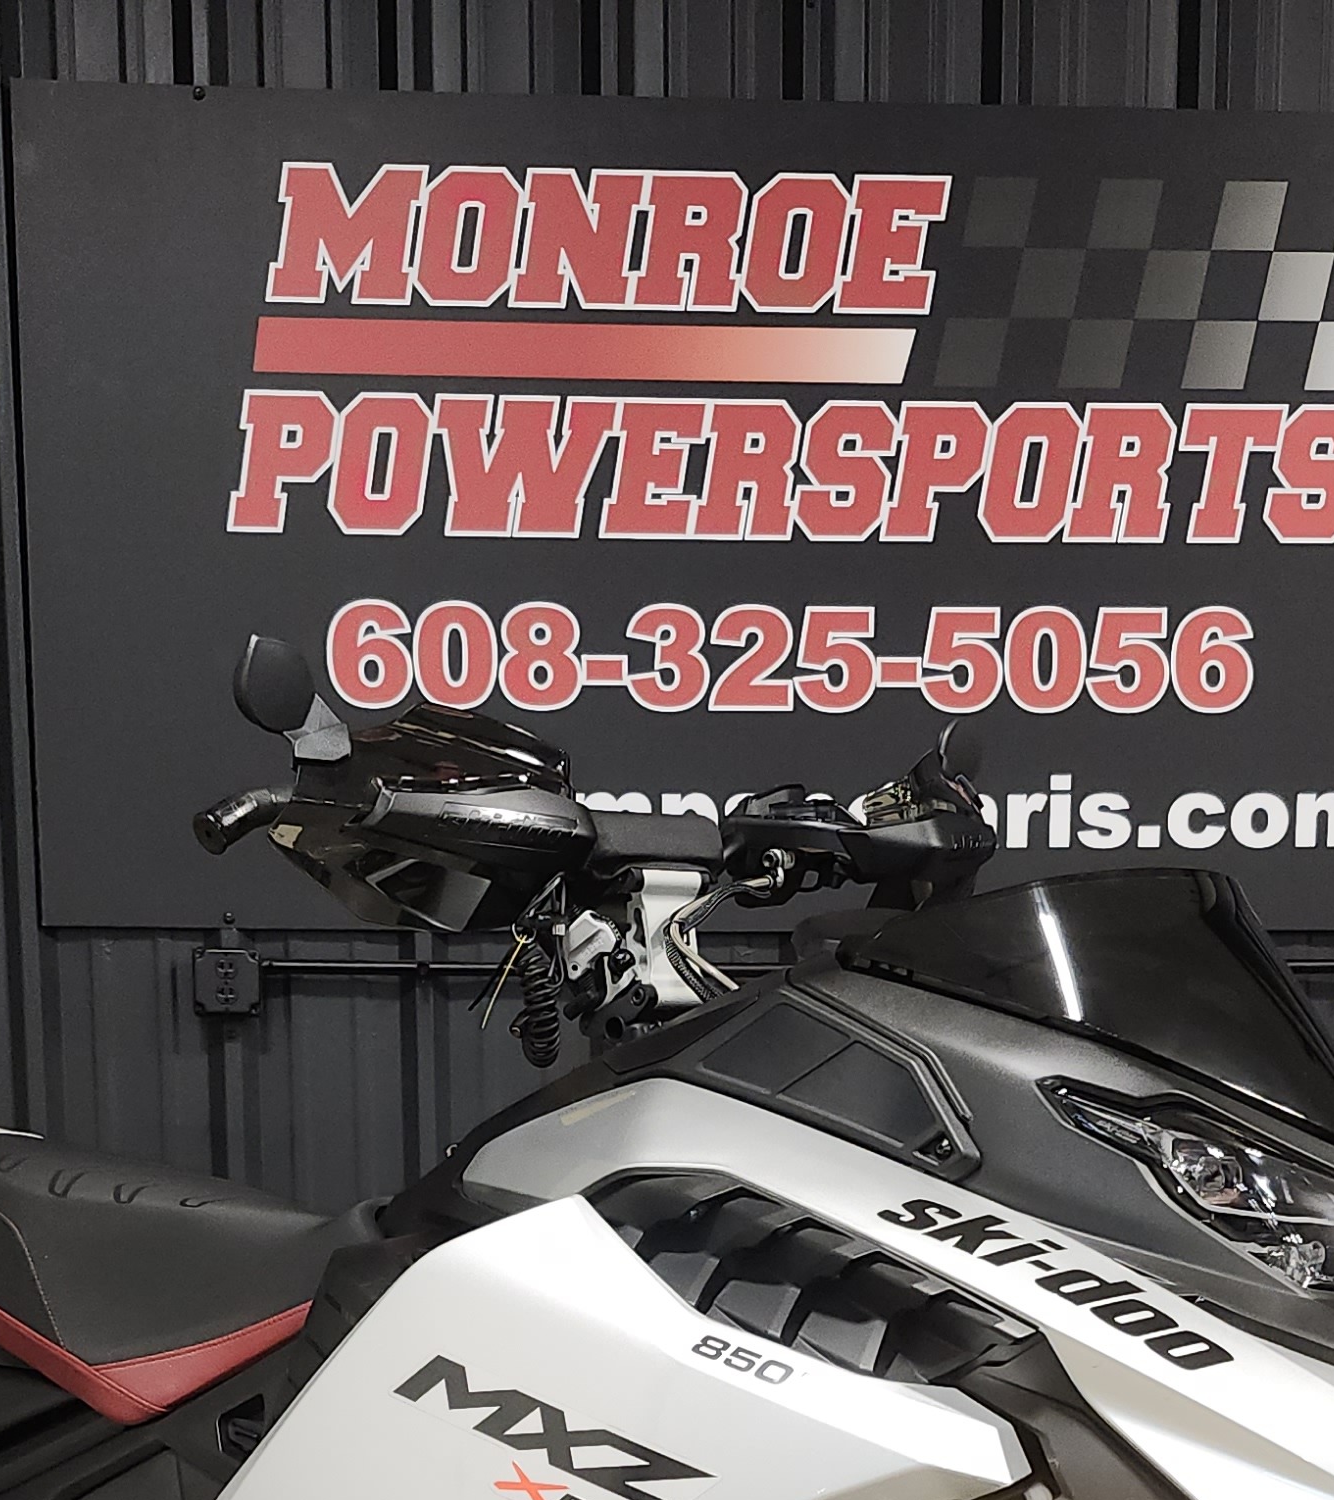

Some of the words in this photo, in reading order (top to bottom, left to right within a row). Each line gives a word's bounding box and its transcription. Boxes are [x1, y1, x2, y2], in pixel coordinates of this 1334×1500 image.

[265, 162, 953, 315] MONROE
[325, 599, 1255, 714] 608-325-5056
[691, 1335, 794, 1385] 850
